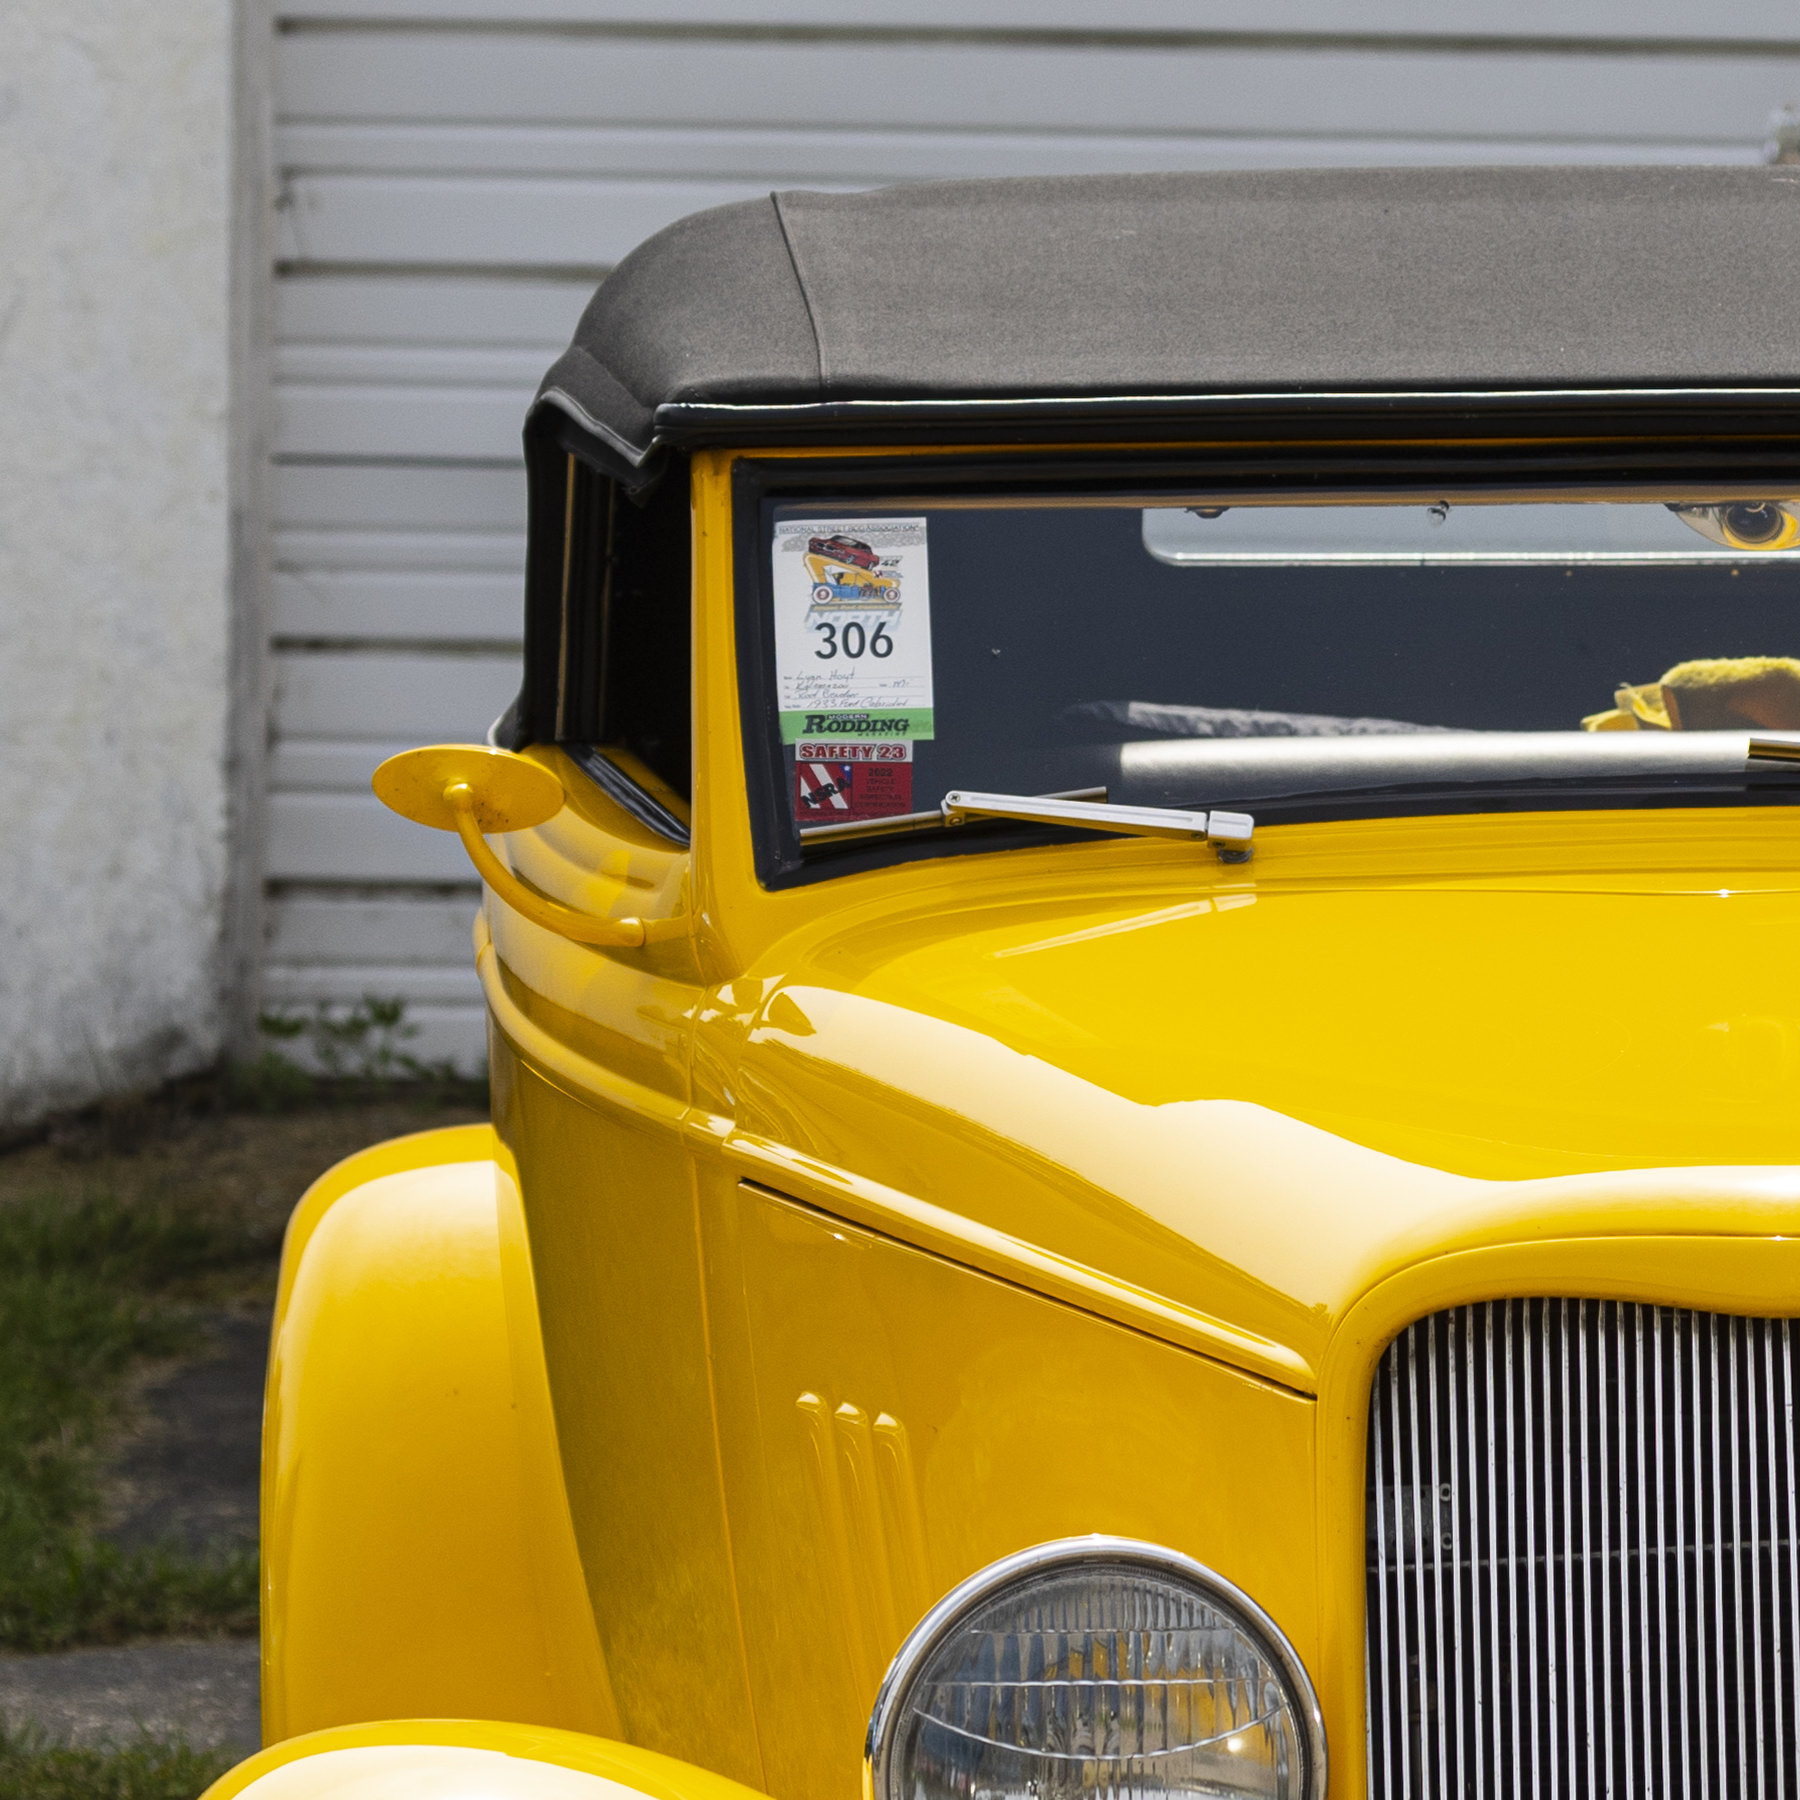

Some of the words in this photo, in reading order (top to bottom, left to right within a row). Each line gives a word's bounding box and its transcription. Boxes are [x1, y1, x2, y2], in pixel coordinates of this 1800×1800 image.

[815, 621, 894, 660] 306
[800, 743, 875, 760] SAFETY
[877, 743, 907, 760] 23
[801, 777, 852, 809] NSRA
